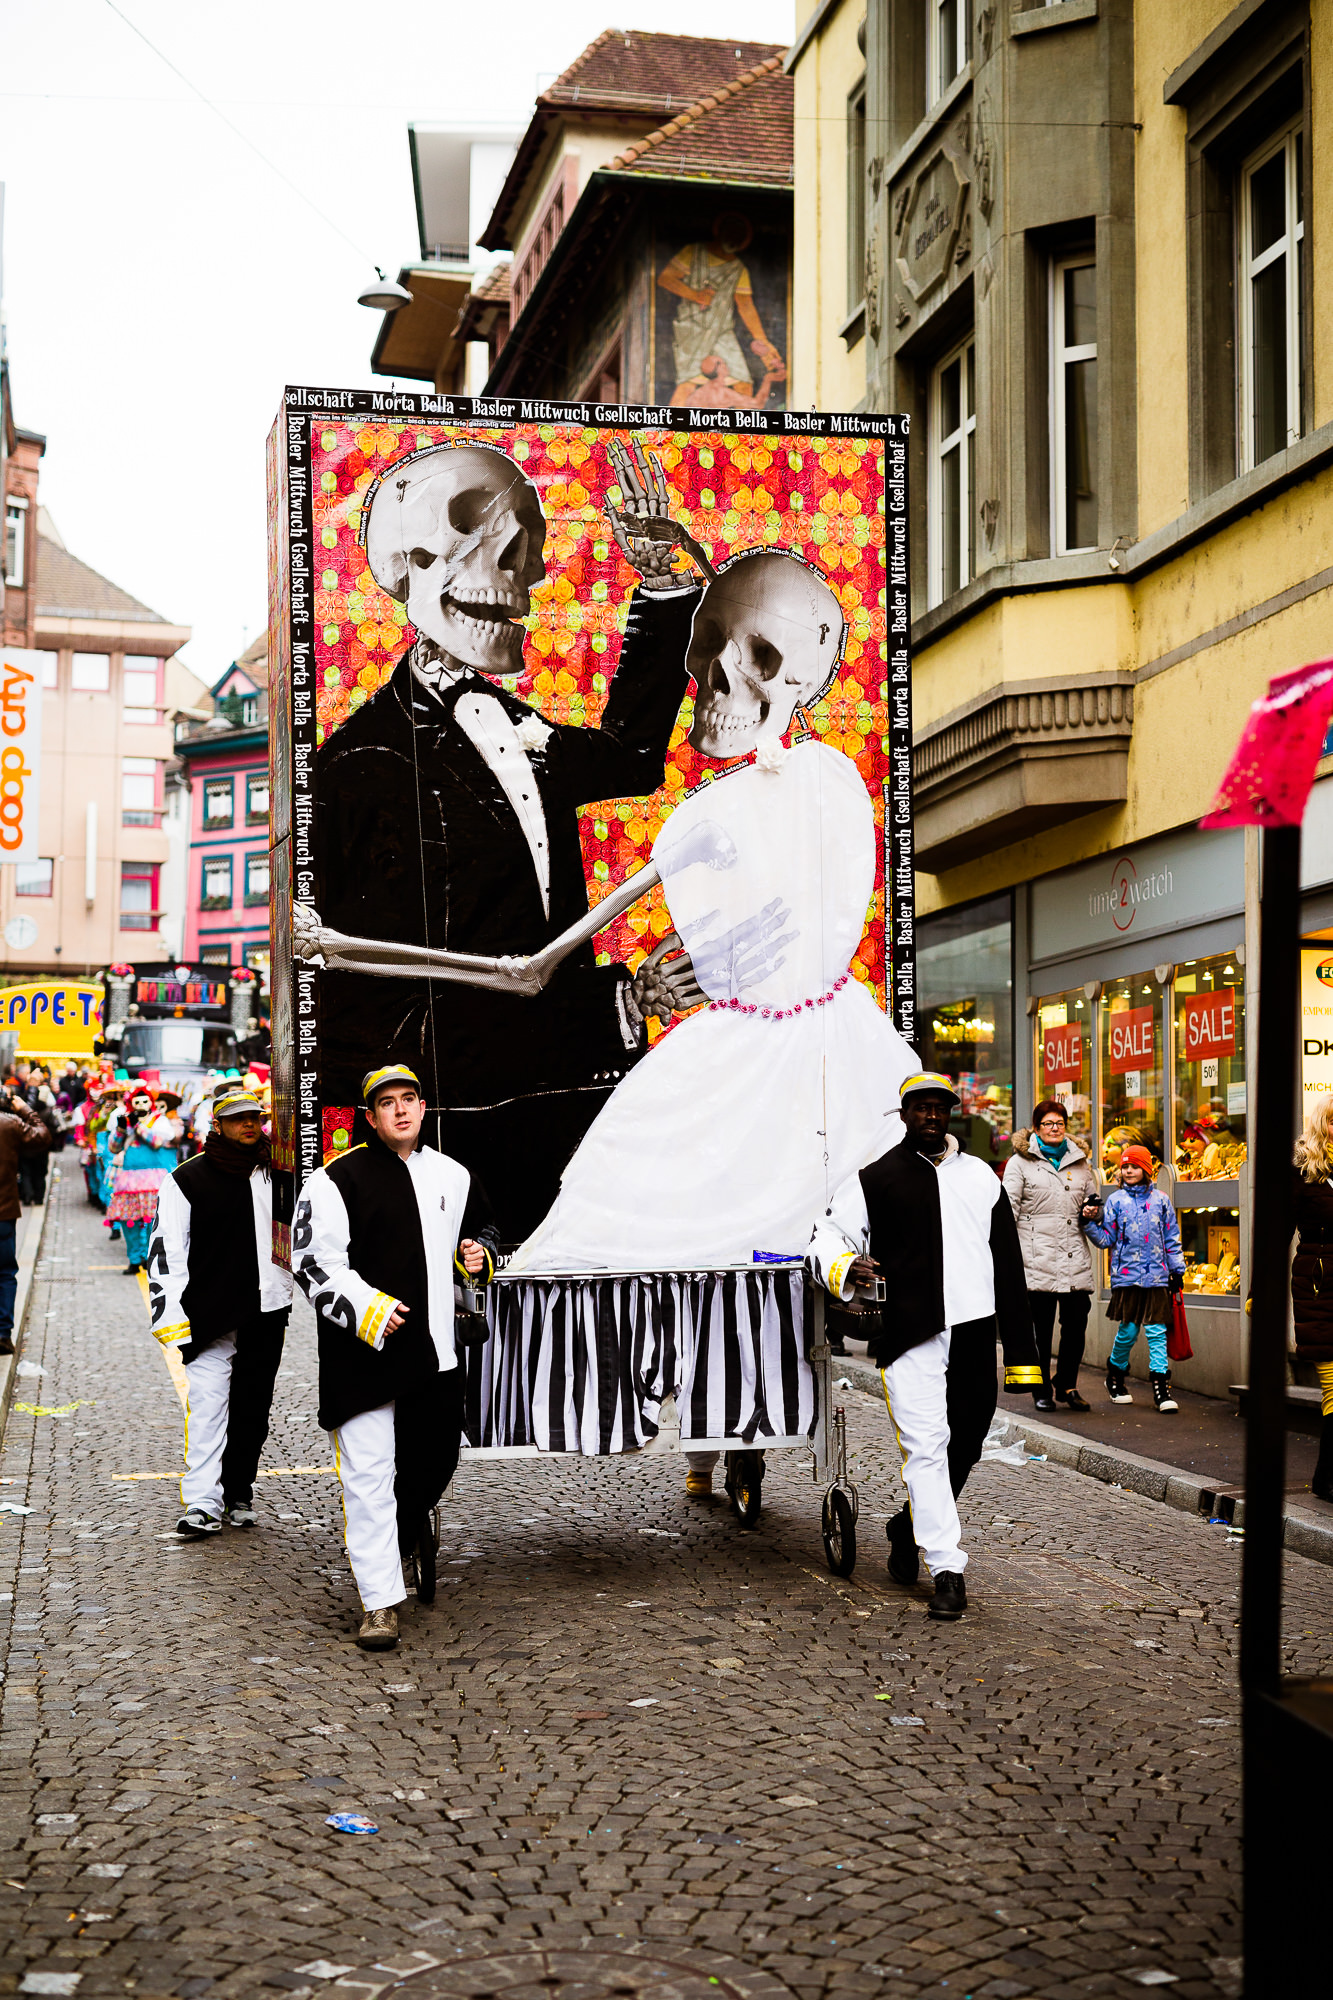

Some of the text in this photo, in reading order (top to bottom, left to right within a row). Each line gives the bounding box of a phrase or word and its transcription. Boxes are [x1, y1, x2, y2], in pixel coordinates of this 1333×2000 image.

[372, 392, 415, 412] Morta
[420, 395, 455, 415] Bella
[472, 398, 515, 417] Basler
[520, 401, 590, 422] Mittwuch
[594, 405, 673, 425] Gsellschaft
[688, 409, 732, 427] Morta
[735, 411, 768, 429] Bella
[784, 413, 826, 431] Basler
[831, 415, 896, 435] Mittwuch
[288, 416, 306, 461] Basler
[289, 466, 308, 538] Mittwuch
[889, 516, 907, 585] Mittwuch
[291, 542, 309, 624] Gsellschaft
[890, 590, 907, 633] Basler
[292, 641, 310, 686] Morta
[890, 649, 908, 683] Bella
[294, 691, 312, 726] Bella
[892, 688, 909, 730] Morta
[0, 662, 35, 851] coop city
[295, 743, 313, 788] Basler
[893, 746, 911, 824] Gsellschaft
[295, 793, 314, 865] Mittwuch
[894, 829, 912, 898] Mittwuch
[896, 902, 913, 946] Basler
[297, 970, 316, 1014] Morta
[896, 961, 914, 995] Bella
[299, 1019, 317, 1055] Bella
[897, 1000, 915, 1042] Morta
[1113, 1021, 1152, 1060] SALE
[1188, 1005, 1234, 1047] SALE
[1046, 1036, 1080, 1072] SALE
[1203, 1063, 1218, 1079] 50%
[300, 1072, 318, 1117] Basler
[1304, 1082, 1333, 1092] MICH
